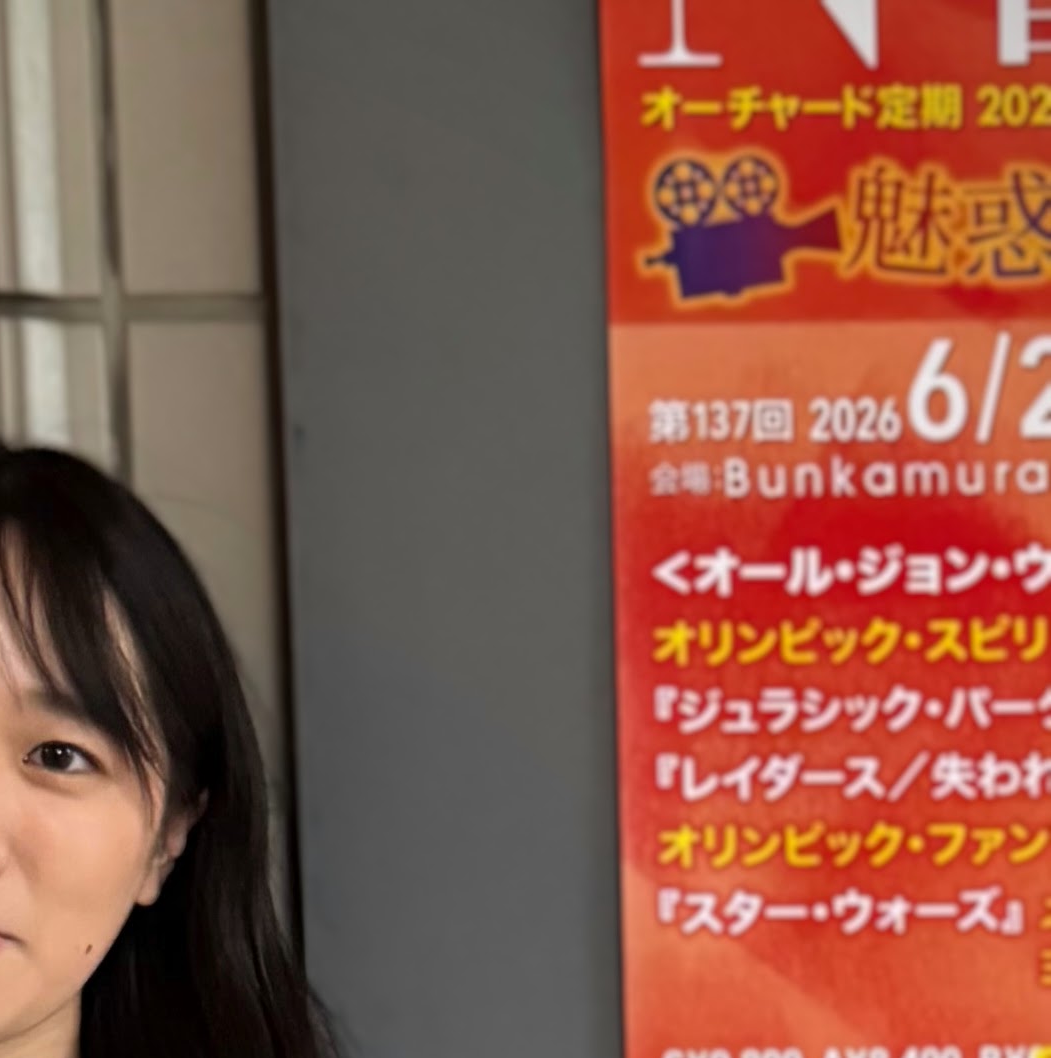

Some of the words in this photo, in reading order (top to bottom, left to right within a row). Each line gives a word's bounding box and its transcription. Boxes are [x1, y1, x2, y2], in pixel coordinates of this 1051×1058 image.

[641, 84, 963, 130] オーチャード定期
[648, 398, 795, 443] 第137回
[809, 396, 903, 442] 2026
[654, 614, 1048, 668] オリンピック・スピリ
[658, 821, 1049, 869] オリンピック・ファン
[658, 885, 1024, 936] 『スター・ウォーズ』
